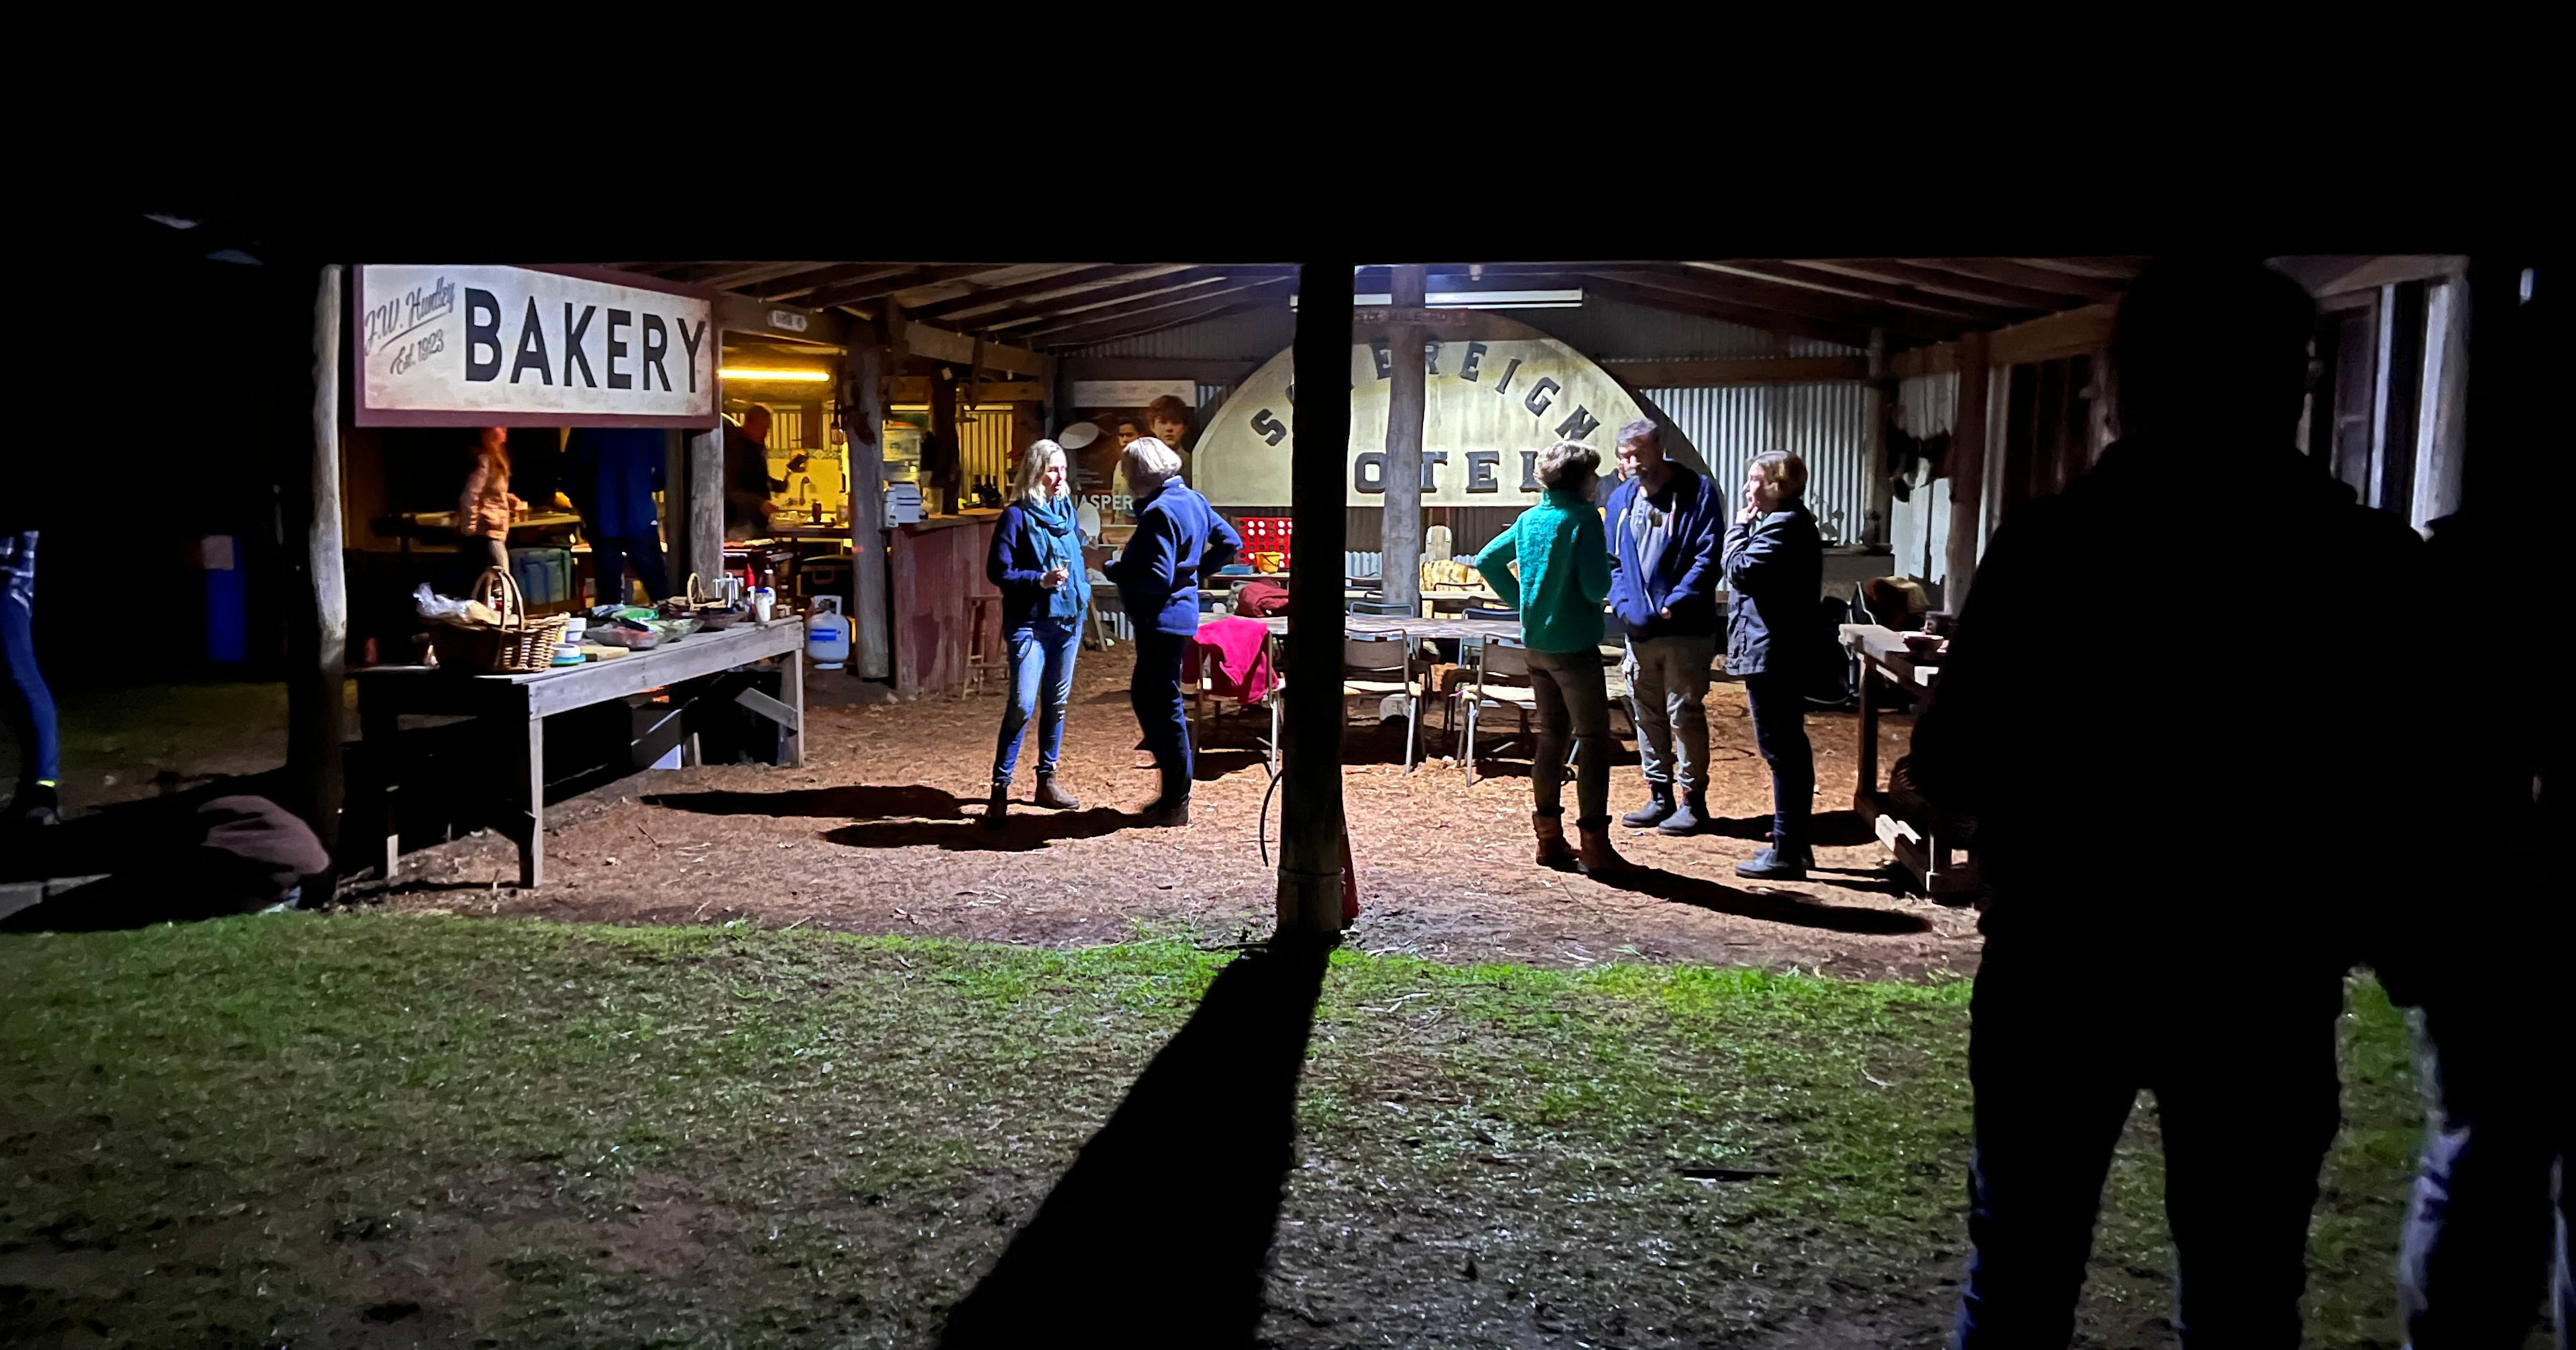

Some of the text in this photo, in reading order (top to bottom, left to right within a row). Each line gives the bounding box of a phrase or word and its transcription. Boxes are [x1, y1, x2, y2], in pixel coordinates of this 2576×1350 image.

[418, 329, 445, 362] 1923
[465, 287, 706, 393] BAKERY
[1354, 451, 1543, 494] OTEL
